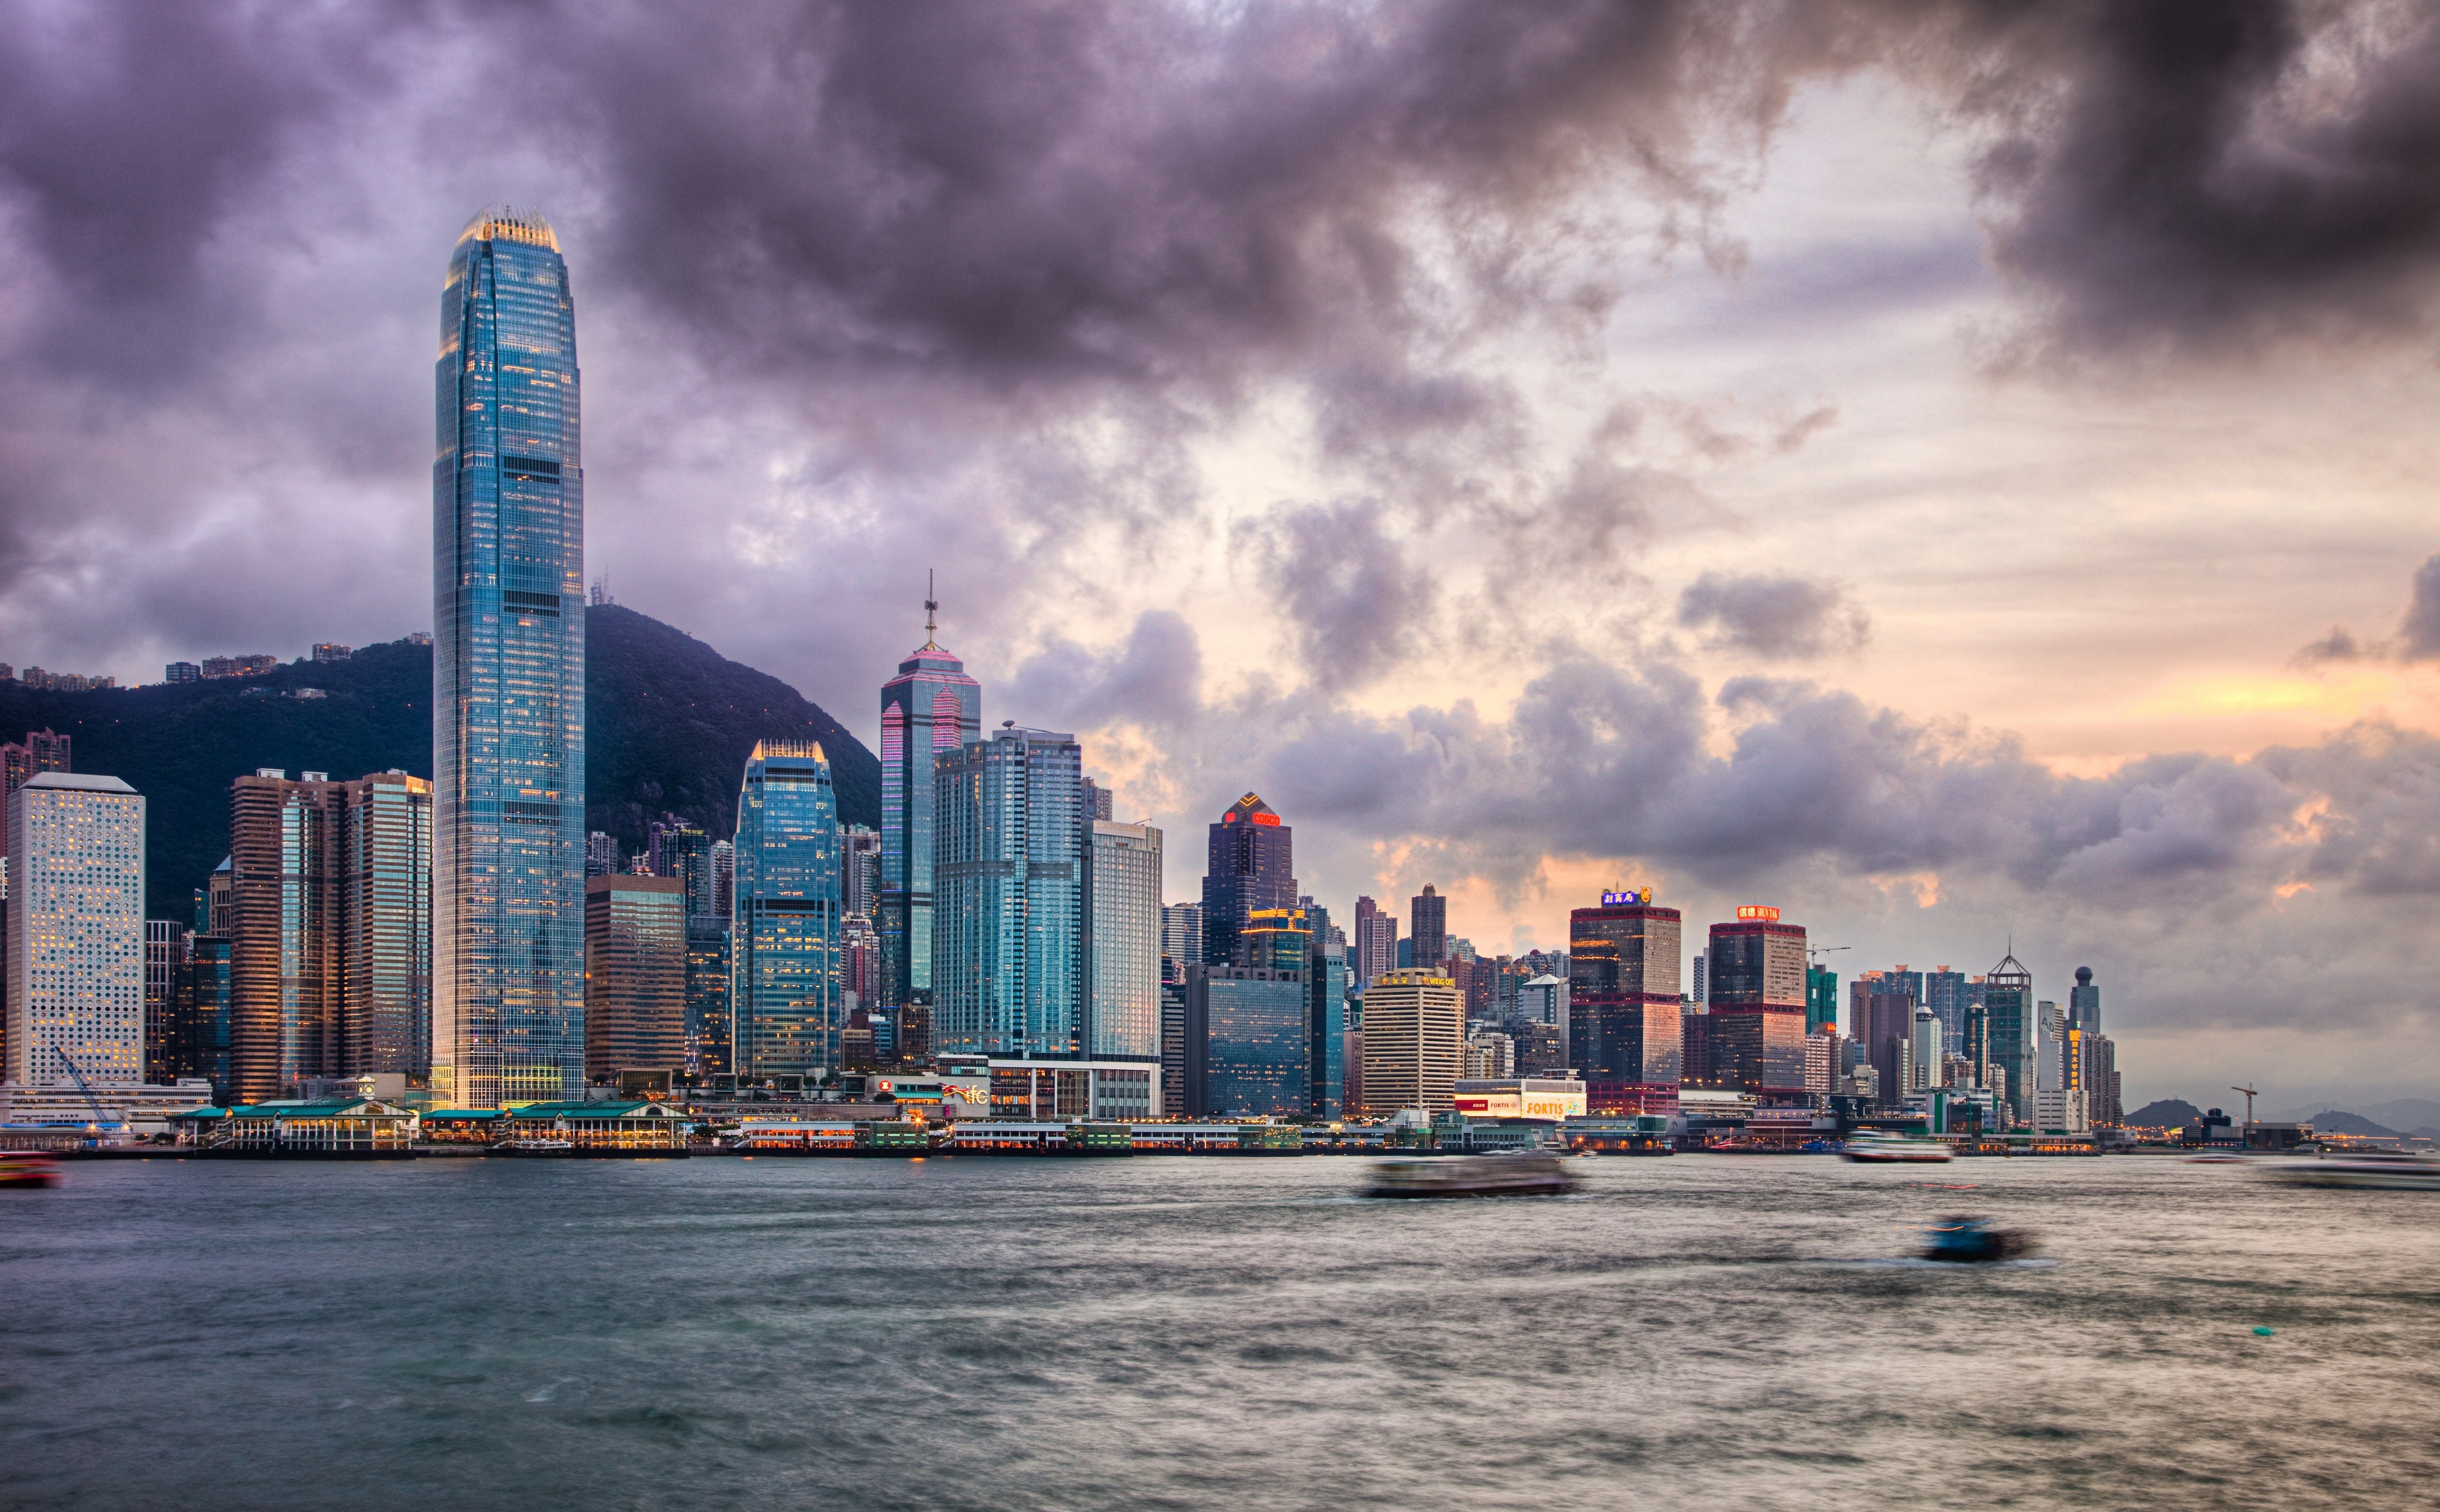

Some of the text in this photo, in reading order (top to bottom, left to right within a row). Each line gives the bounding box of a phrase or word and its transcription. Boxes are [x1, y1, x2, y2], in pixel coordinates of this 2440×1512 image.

[1253, 812, 1281, 826] COSCO
[1605, 893, 1633, 903] 招商局
[1739, 907, 1756, 917] 信德
[1757, 907, 1778, 919] SHUN TAK
[966, 1085, 988, 1104] ifc
[1528, 1103, 1563, 1114] FORTIS
